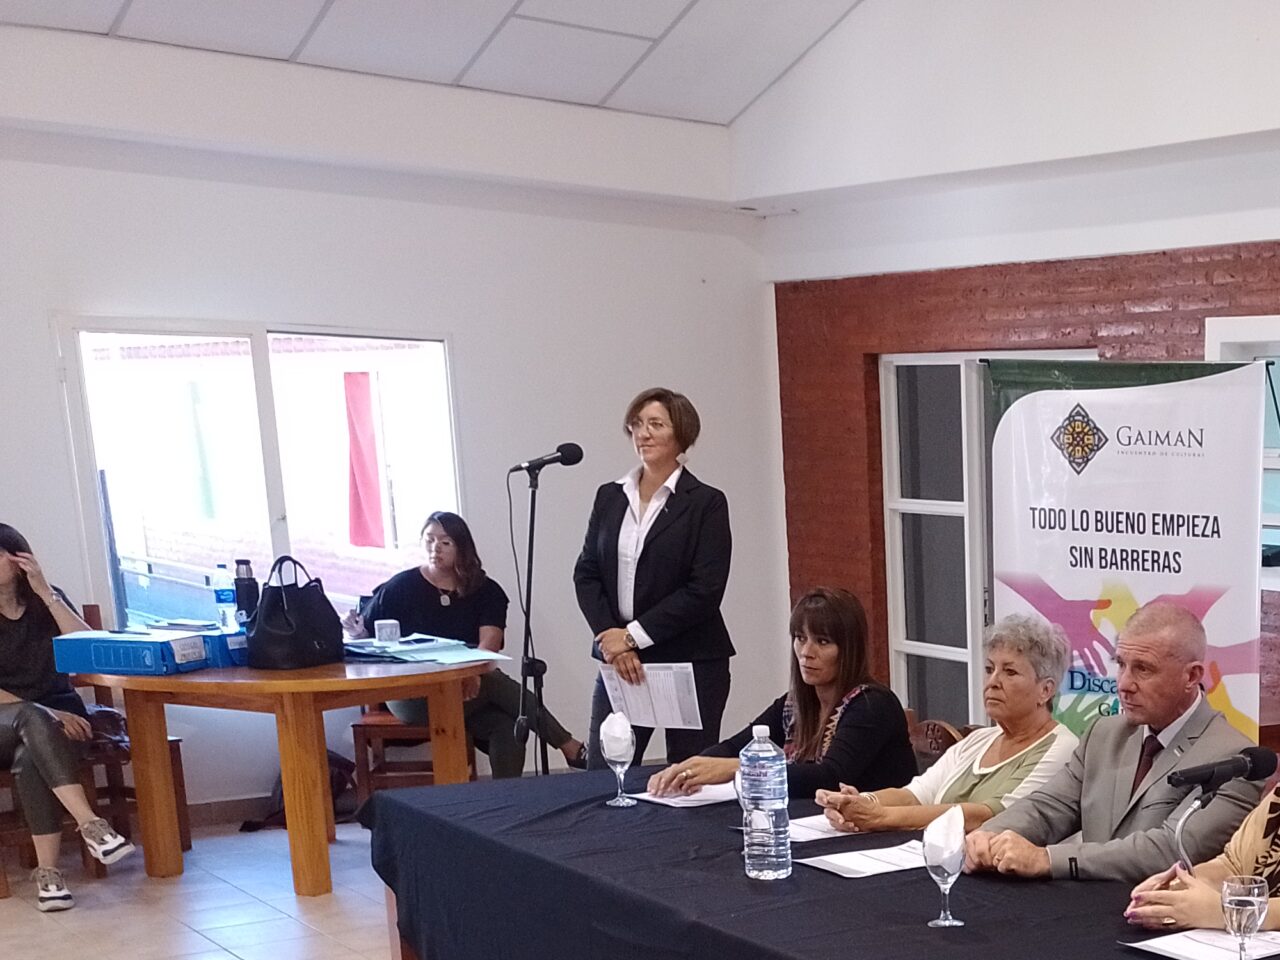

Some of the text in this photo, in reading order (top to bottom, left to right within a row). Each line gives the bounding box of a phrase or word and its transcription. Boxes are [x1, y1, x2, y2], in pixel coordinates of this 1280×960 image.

[1029, 507, 1221, 539] TODO LO BUENO EMPIEZA
[1069, 546, 1182, 574] SIN BARRERAS
